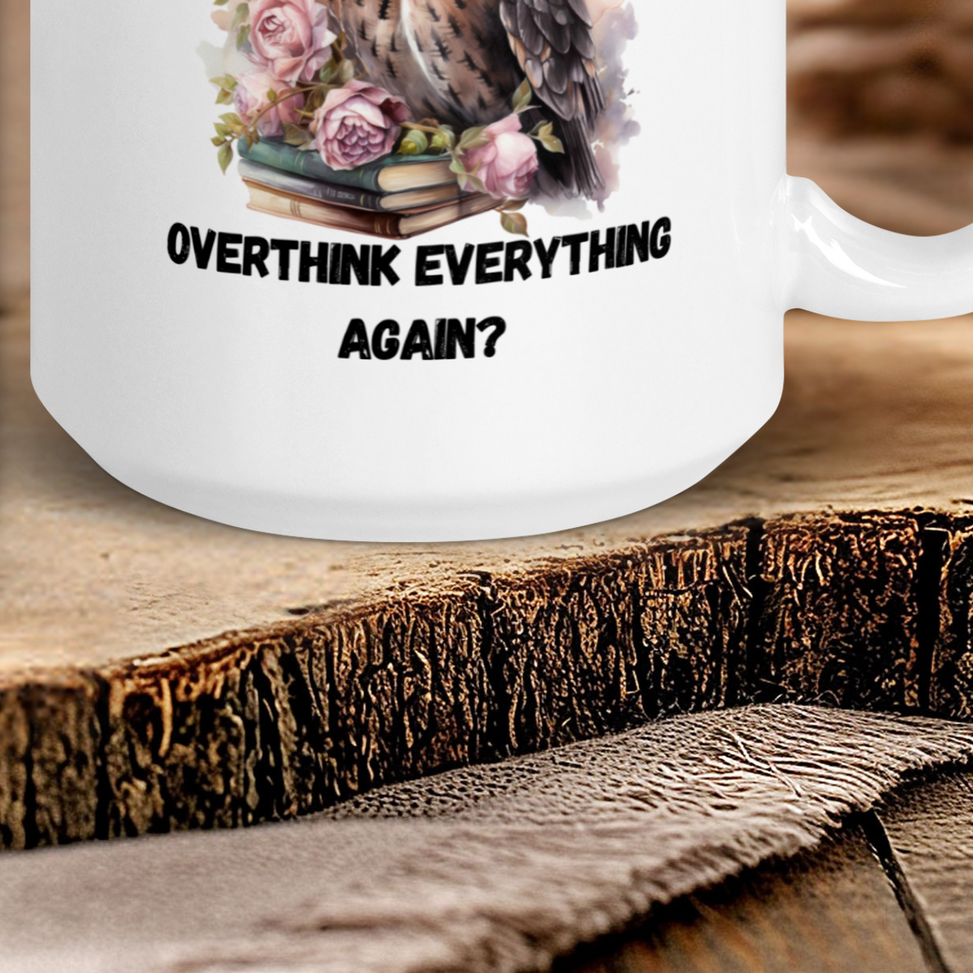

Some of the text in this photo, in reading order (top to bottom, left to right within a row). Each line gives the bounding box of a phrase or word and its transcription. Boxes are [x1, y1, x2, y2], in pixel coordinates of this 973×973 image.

[166, 216, 672, 287] OVERTHINK EVERYTHING
[337, 316, 507, 361] AGAIN?
